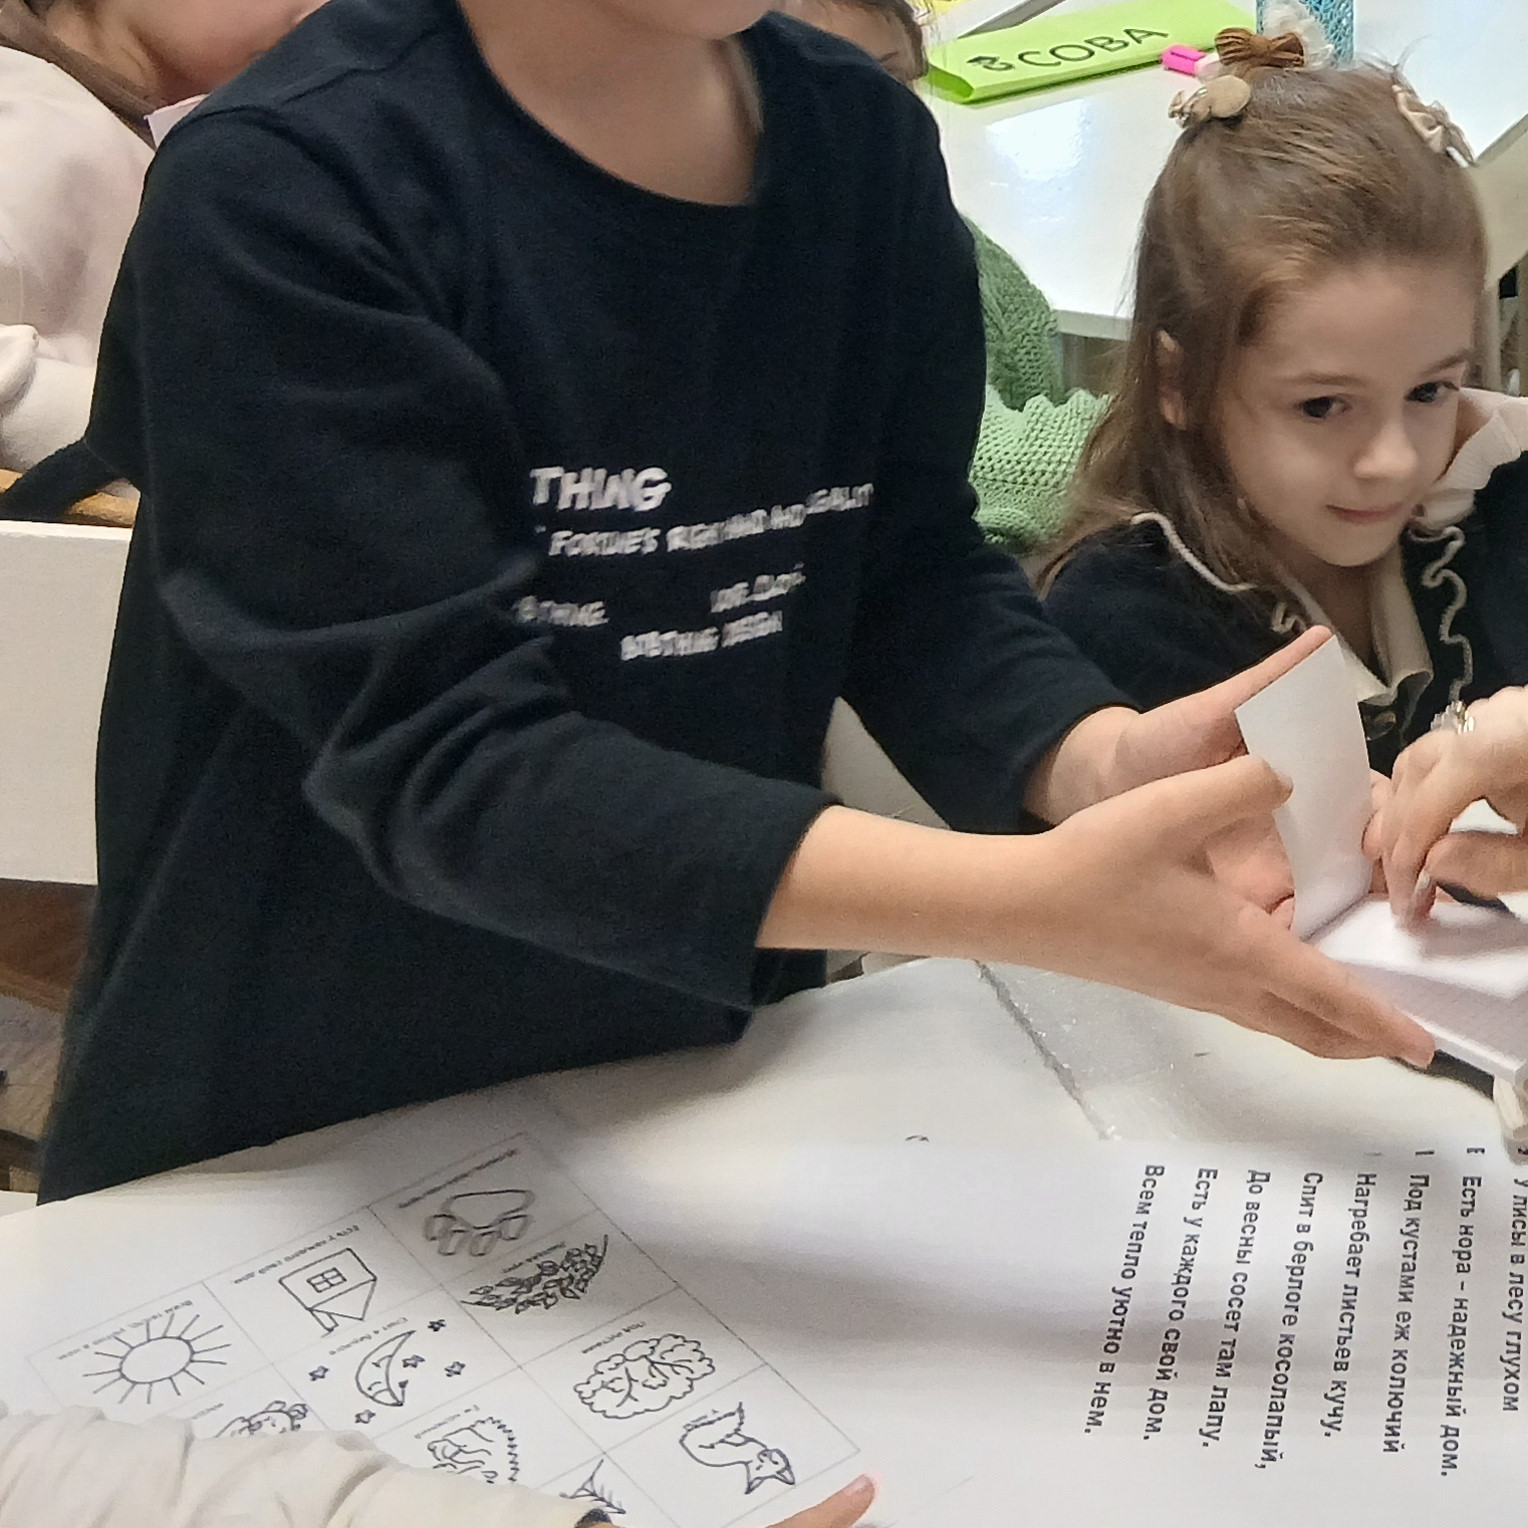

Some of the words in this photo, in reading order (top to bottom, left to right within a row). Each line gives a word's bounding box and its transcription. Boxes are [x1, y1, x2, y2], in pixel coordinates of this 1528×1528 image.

[1017, 27, 1169, 67] СОВА
[1135, 1164, 1166, 1215] Всем
[1191, 1167, 1219, 1211] Есть
[1245, 1169, 1272, 1195] До
[1298, 1172, 1324, 1218] Спит
[1402, 1174, 1430, 1212] Под
[1459, 1175, 1483, 1218] Есть
[1182, 1216, 1204, 1229] у
[1235, 1201, 1261, 1265] весны
[1295, 1223, 1312, 1234] в
[1344, 1173, 1378, 1279] Нагребает
[1510, 1194, 1528, 1247] лисы
[1120, 1220, 1148, 1280] тепло
[1397, 1217, 1421, 1304] кустами
[1451, 1224, 1475, 1274] нора
[1509, 1253, 1526, 1265] в
[1167, 1233, 1201, 1322] каждого
[1223, 1271, 1249, 1333] сосет
[1281, 1240, 1315, 1327] берлоге
[1501, 1270, 1525, 1325] лесу
[1103, 1285, 1133, 1355] уютно
[1332, 1283, 1359, 1372] листьев
[1393, 1310, 1412, 1342] еж
[1098, 1361, 1116, 1374] в
[1155, 1328, 1181, 1381] свой
[1215, 1337, 1237, 1378] там
[1445, 1297, 1469, 1418] надежный
[1499, 1330, 1522, 1412] глухом
[1083, 1381, 1112, 1434] нем.
[1142, 1387, 1169, 1441] дом.
[1198, 1384, 1229, 1448] лапу.
[1253, 1333, 1296, 1470] косолапый,
[1319, 1379, 1348, 1438] кучу.
[1382, 1348, 1409, 1453] колючий
[1439, 1424, 1460, 1477] дом.
